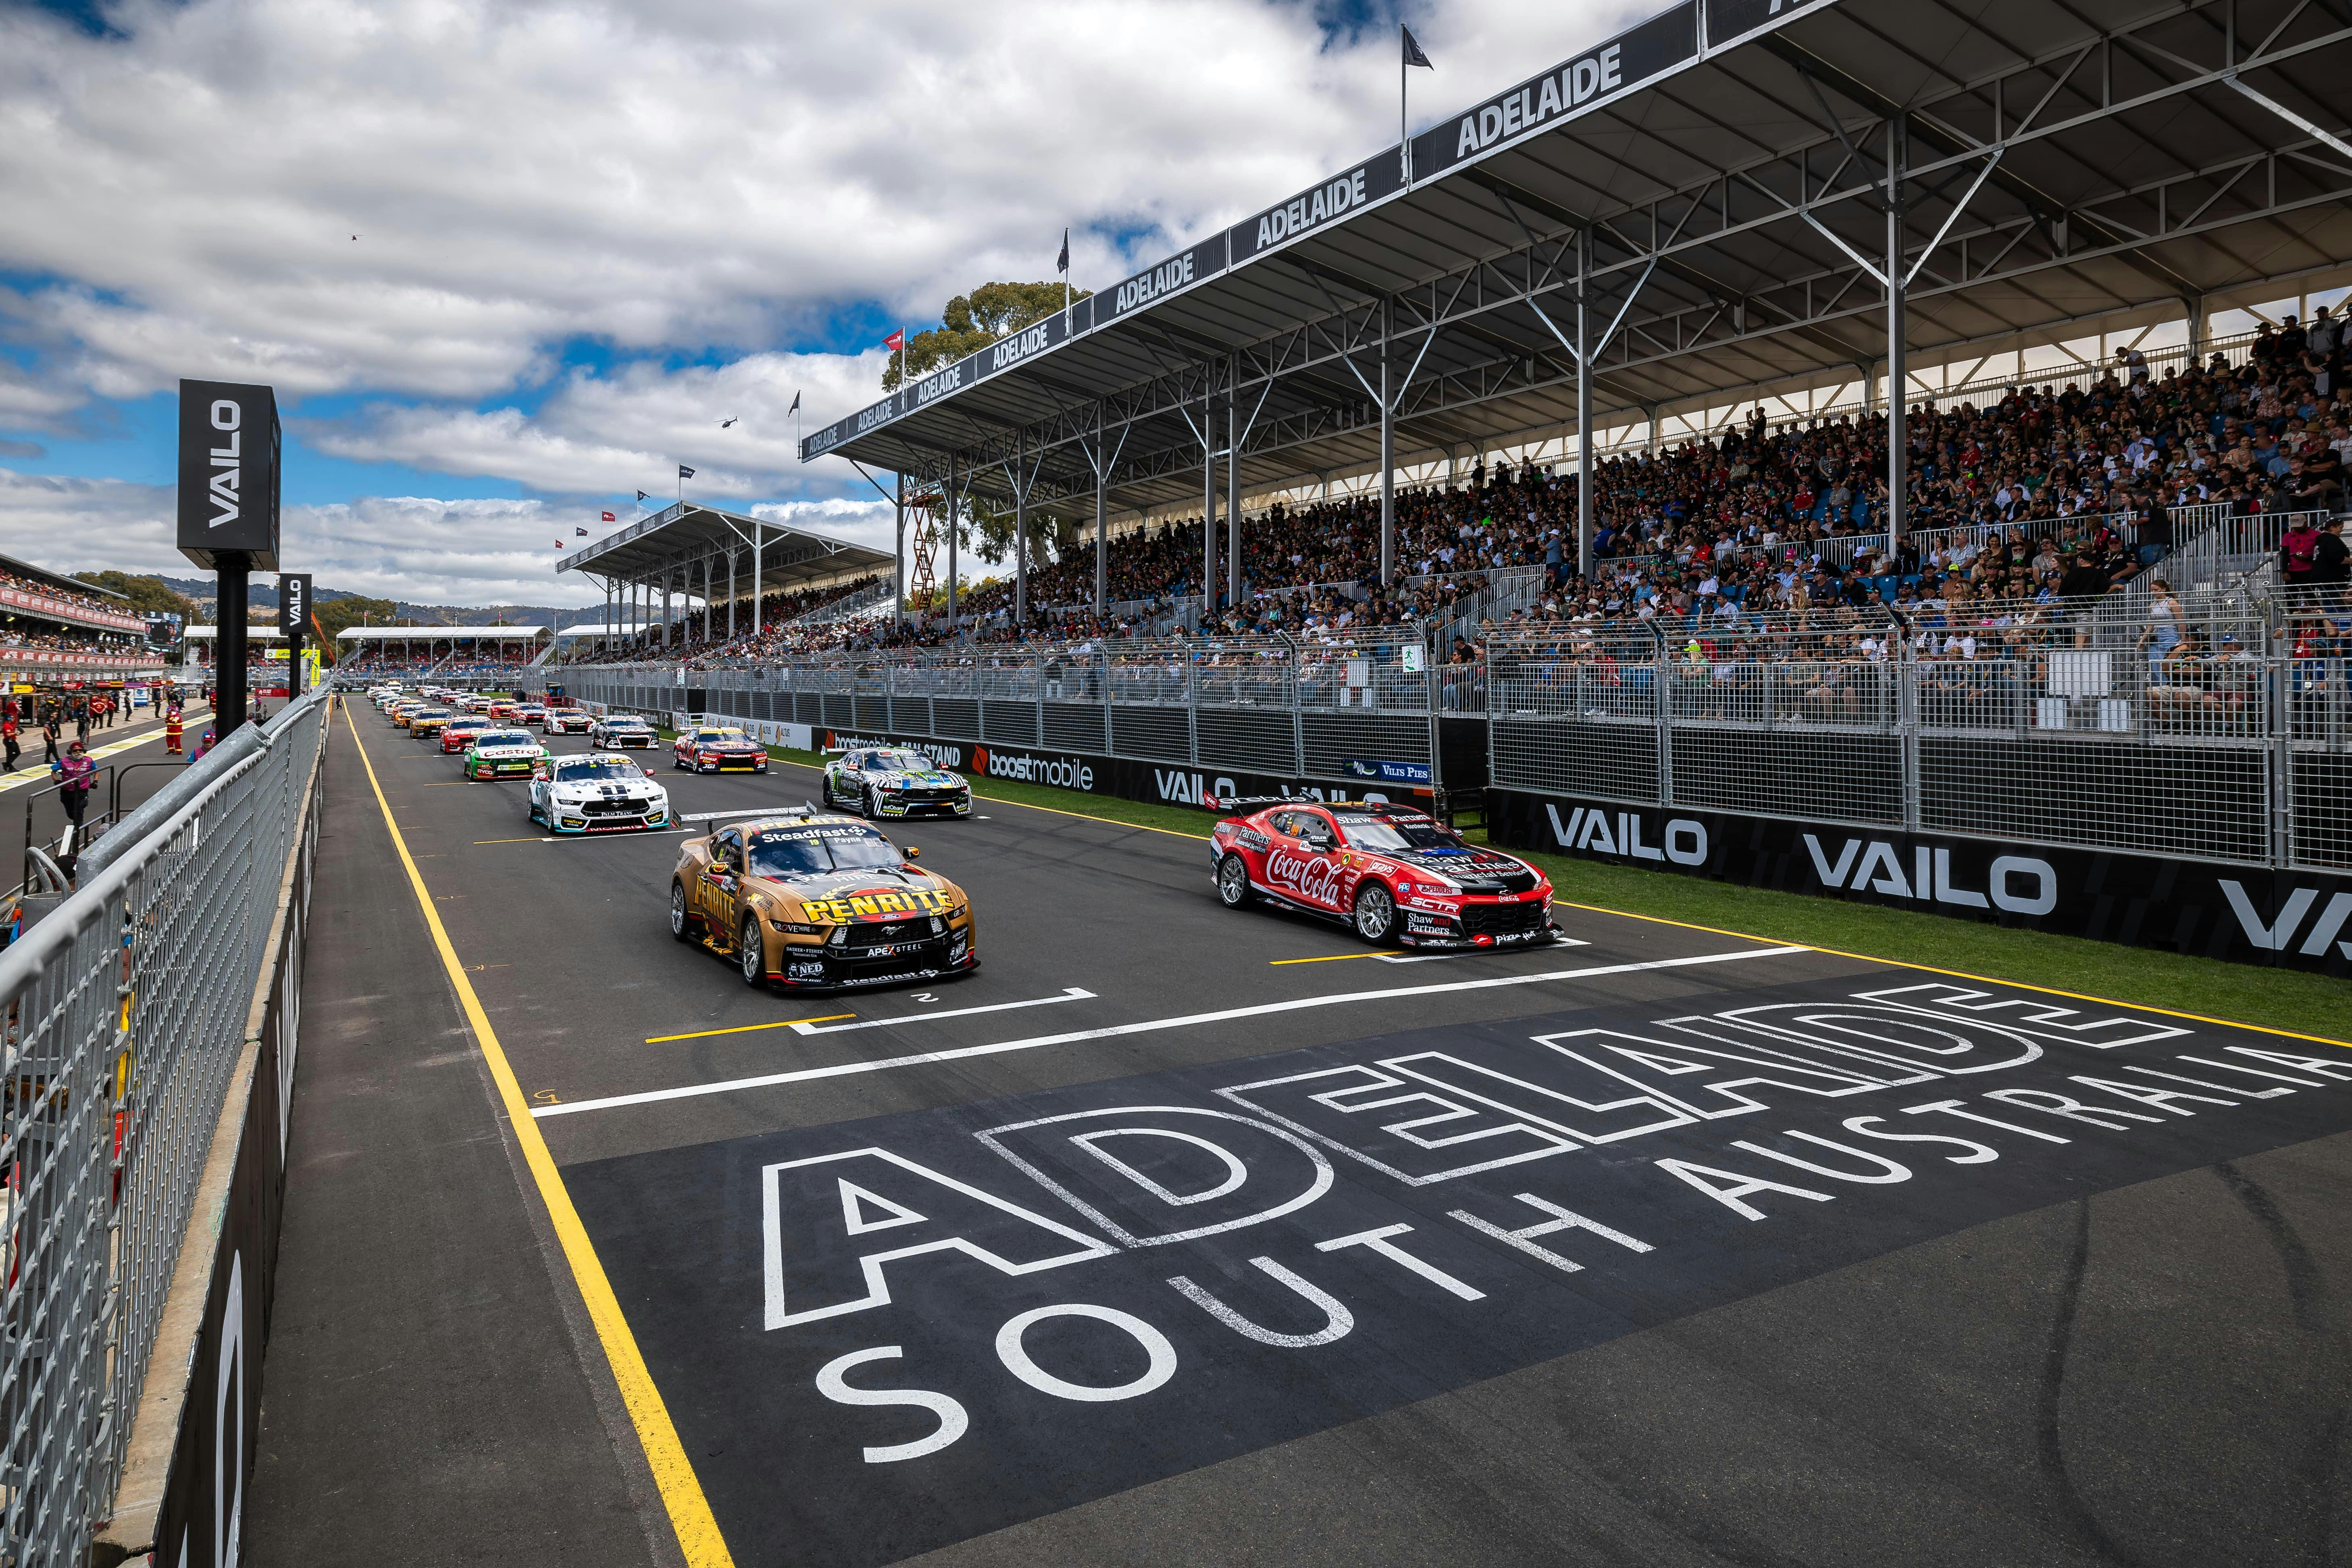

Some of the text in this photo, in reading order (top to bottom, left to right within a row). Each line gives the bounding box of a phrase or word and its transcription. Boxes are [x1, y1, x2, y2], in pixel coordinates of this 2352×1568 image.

[1457, 43, 1621, 158] ADELAIDE
[1256, 168, 1366, 250] ADELAIDE
[1116, 252, 1193, 314] ADELAIDE
[993, 323, 1047, 370] ADELAIDE
[918, 365, 961, 404] ADELAIDE
[858, 400, 892, 432] ADELAIDE
[809, 425, 837, 454] ADELAIDE
[209, 400, 240, 528] VAILO
[663, 506, 677, 523] ADELAIDE
[643, 516, 655, 532] ADELAIDE
[625, 524, 636, 540] ADELAIDE
[610, 535, 619, 547] ADELAIDE
[290, 580, 301, 626] VAILO
[763, 726, 771, 735] ALTUS
[781, 727, 790, 737] ALTUS
[924, 744, 960, 766] STAND
[989, 749, 1093, 790] boostmobile
[1354, 761, 1365, 775] Milk
[1407, 767, 1428, 779] PIES
[570, 779, 649, 787] Mobil
[607, 786, 618, 794] 1
[841, 779, 858, 790] MONSTER
[1206, 796, 1216, 806] grays
[1220, 795, 1307, 804] erebus
[686, 808, 768, 820] GROVE
[1388, 814, 1431, 822] Partners
[759, 816, 858, 831] PENRITE
[1290, 825, 1300, 836] 99
[762, 827, 849, 843] Steadfast
[1217, 822, 1232, 834] Shaw
[1239, 826, 1271, 845] Partners
[1546, 802, 1708, 866] VAILO
[1234, 838, 1266, 854] Financial Services
[1370, 861, 1395, 873] grays
[1422, 860, 1520, 873] Partners
[1499, 867, 1529, 877] Services
[834, 873, 880, 883] HIRE
[1803, 833, 2056, 916] VAILO
[694, 875, 736, 929] PENRITE
[801, 888, 955, 923] PENRITE
[1410, 896, 1459, 913] SCTR
[774, 922, 798, 933] GROVE
[1407, 922, 1450, 935] Partners
[867, 943, 922, 957] APEX STEEL
[955, 942, 965, 956] NED
[799, 964, 823, 974] NED
[843, 972, 919, 985] Steadfast
[763, 983, 2196, 1331] ADELAIDE
[815, 1046, 2352, 1465] SOUTH AUSTRALIA
